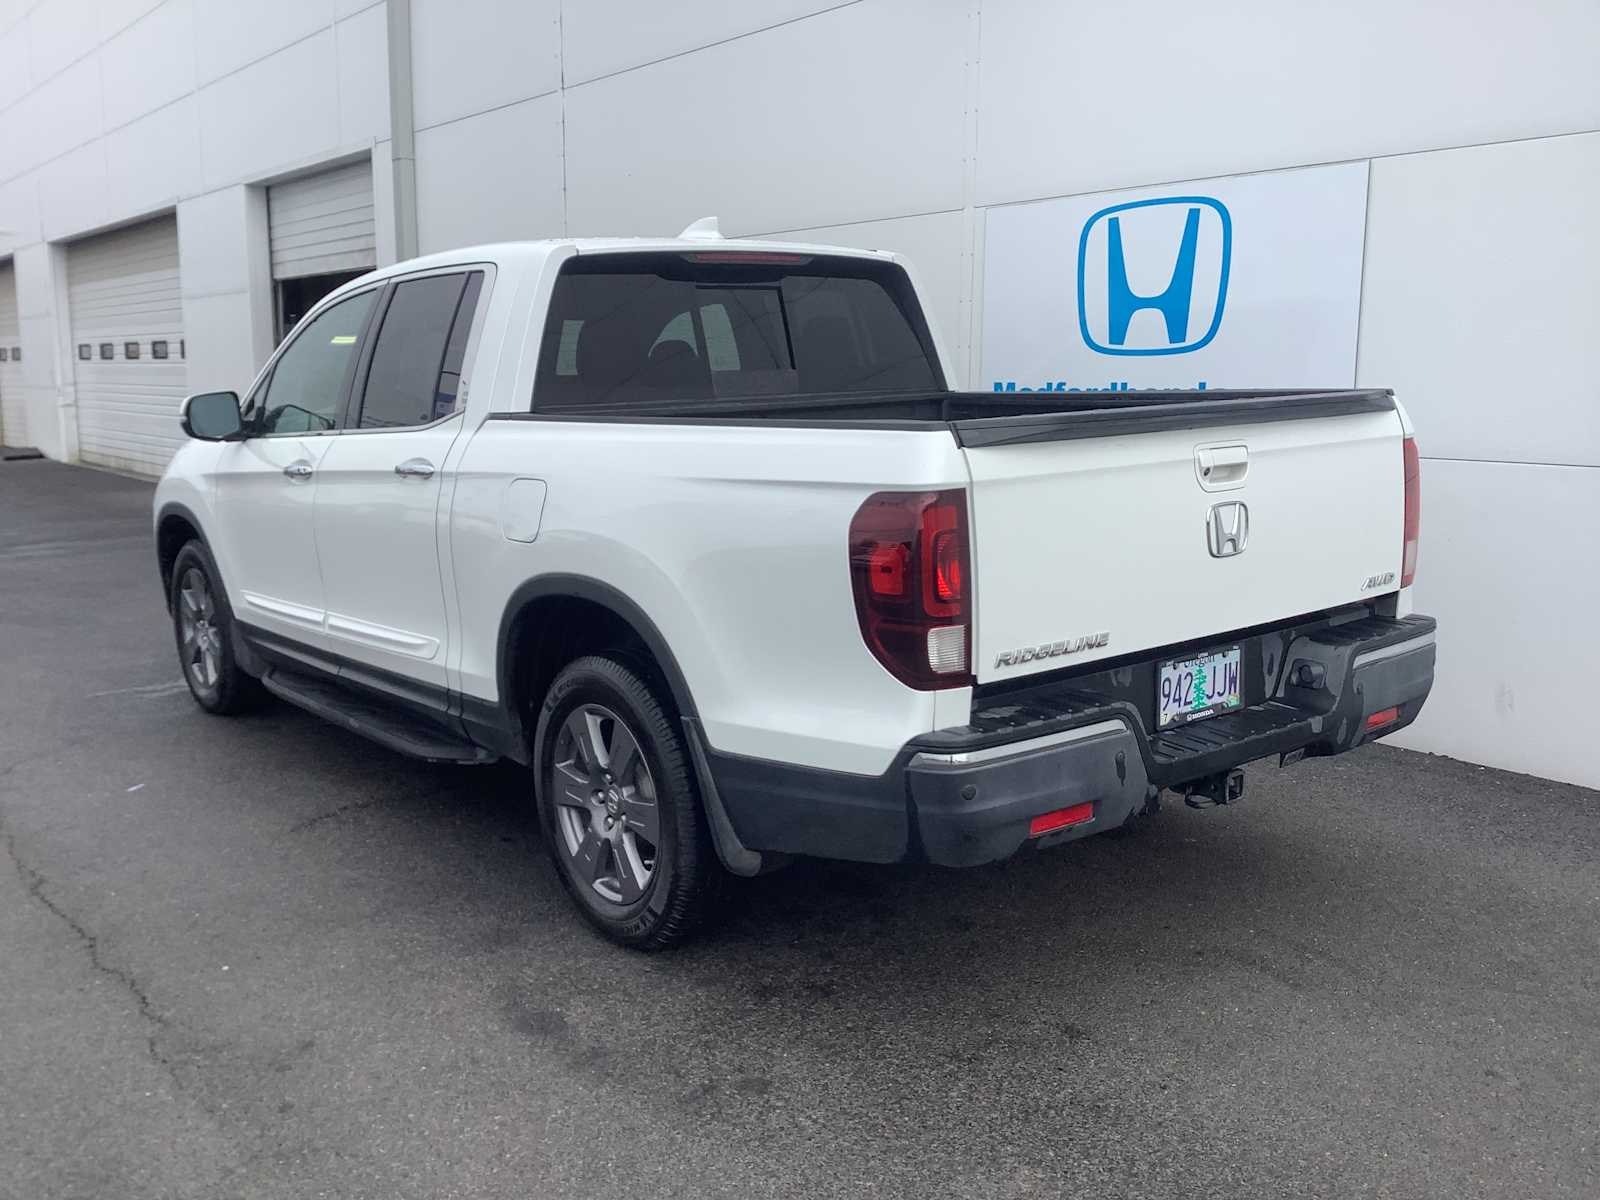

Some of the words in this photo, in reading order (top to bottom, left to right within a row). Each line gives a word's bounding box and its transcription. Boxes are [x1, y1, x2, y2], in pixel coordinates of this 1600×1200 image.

[993, 631, 1110, 669] RIDGELINE
[1162, 671, 1194, 711] 942
[1206, 661, 1239, 700] JJW
